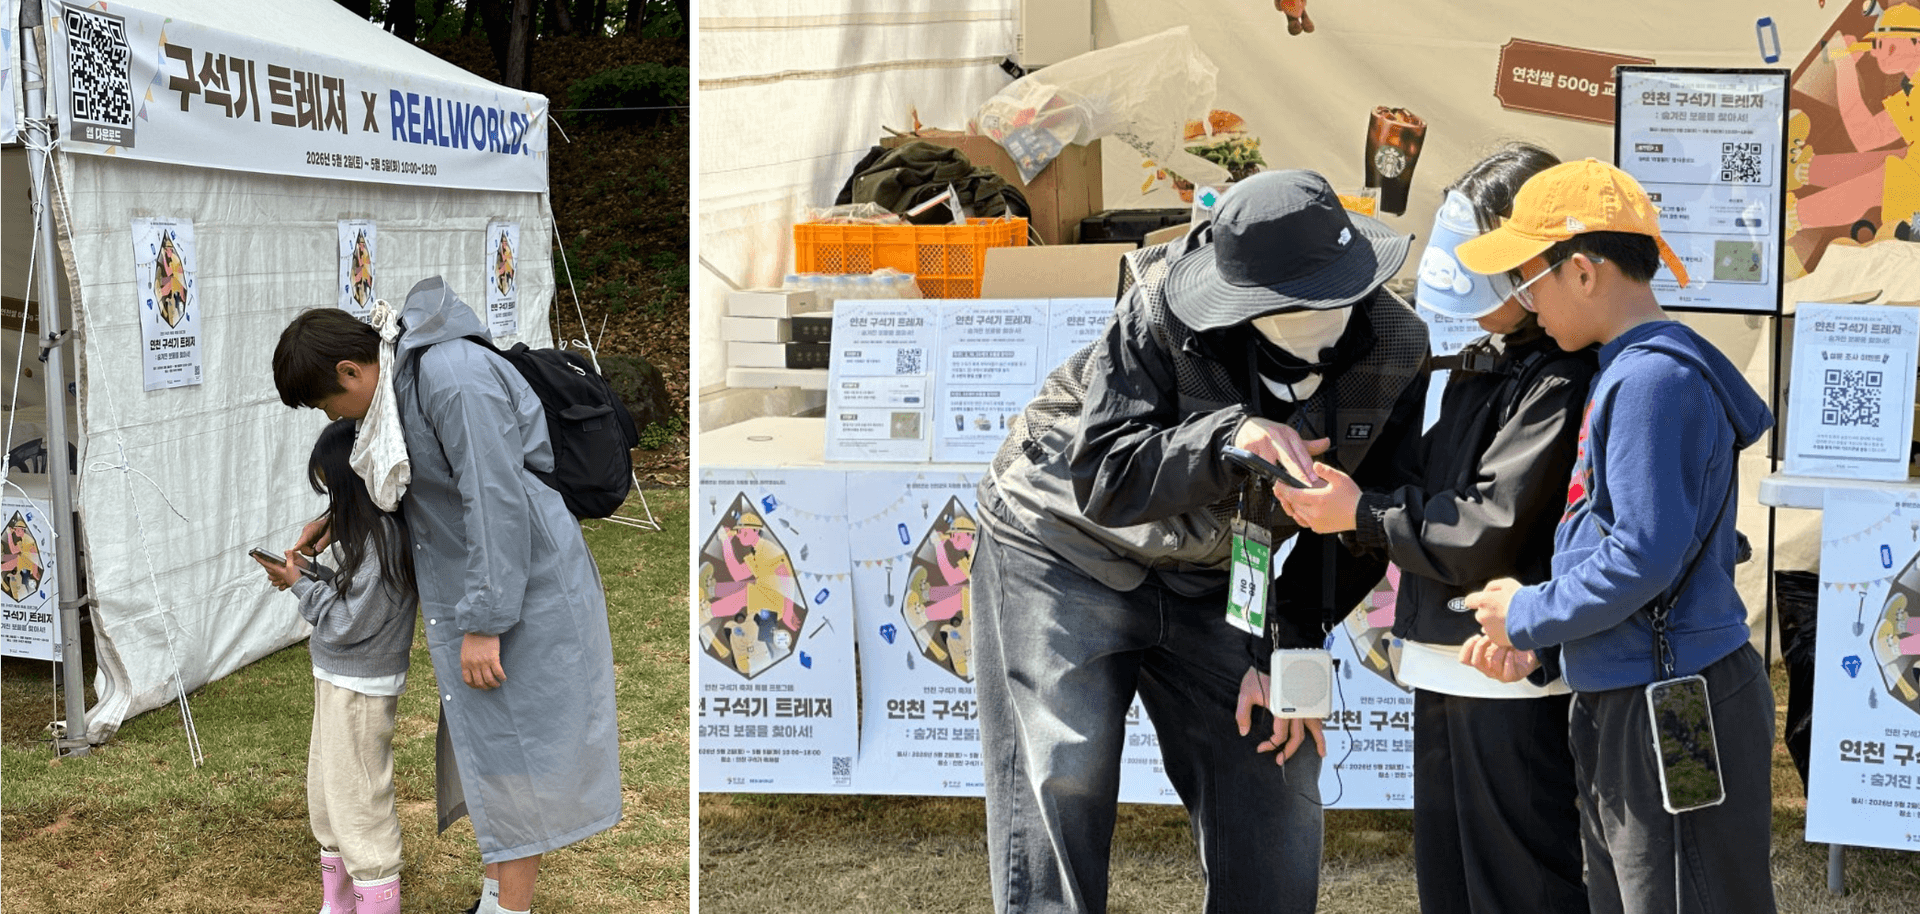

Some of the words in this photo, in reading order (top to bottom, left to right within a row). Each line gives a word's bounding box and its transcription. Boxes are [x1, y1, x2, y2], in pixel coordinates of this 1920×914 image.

[1512, 66, 1555, 88] 연천쌀
[1557, 75, 1599, 97] 500g
[164, 42, 261, 122] 구석기
[267, 63, 348, 135] 트레저
[389, 88, 530, 156] REALWORLD!
[1641, 91, 1671, 106] 연천
[1675, 92, 1716, 107] 구석기
[1720, 94, 1764, 109] 트레저
[86, 126, 93, 139] 앱
[95, 127, 122, 143] 다운로드
[306, 151, 331, 167] 2026년
[331, 153, 343, 168] 5월
[343, 155, 364, 170] 2일(토)
[370, 157, 381, 172] 5월
[381, 158, 401, 173] 5일(화)
[401, 161, 438, 176] 10:00~18:00
[870, 317, 895, 327] 구석기
[897, 317, 924, 327] 트레저
[955, 315, 973, 326] 연천
[975, 315, 1003, 326] 구석기
[1004, 315, 1032, 325] 트레저
[1067, 316, 1085, 326] 연천
[1815, 321, 1835, 333] 연천
[1838, 322, 1868, 334] 구석기
[1870, 324, 1902, 335] 트레저
[162, 337, 179, 350] 구석기
[180, 336, 196, 348] 트레저
[3, 609, 27, 622] 구석기
[713, 697, 768, 718] 구석기
[775, 697, 832, 718] 트레저
[887, 699, 925, 720] 연천
[1369, 710, 1414, 732] 구석
[733, 724, 768, 738] 보물을
[771, 725, 813, 738] 찾아서!
[913, 728, 949, 741] 숨겨진
[1352, 739, 1388, 753] 숨겨진
[1839, 739, 1885, 765] 연천
[1870, 773, 1912, 790] 숨겨진
